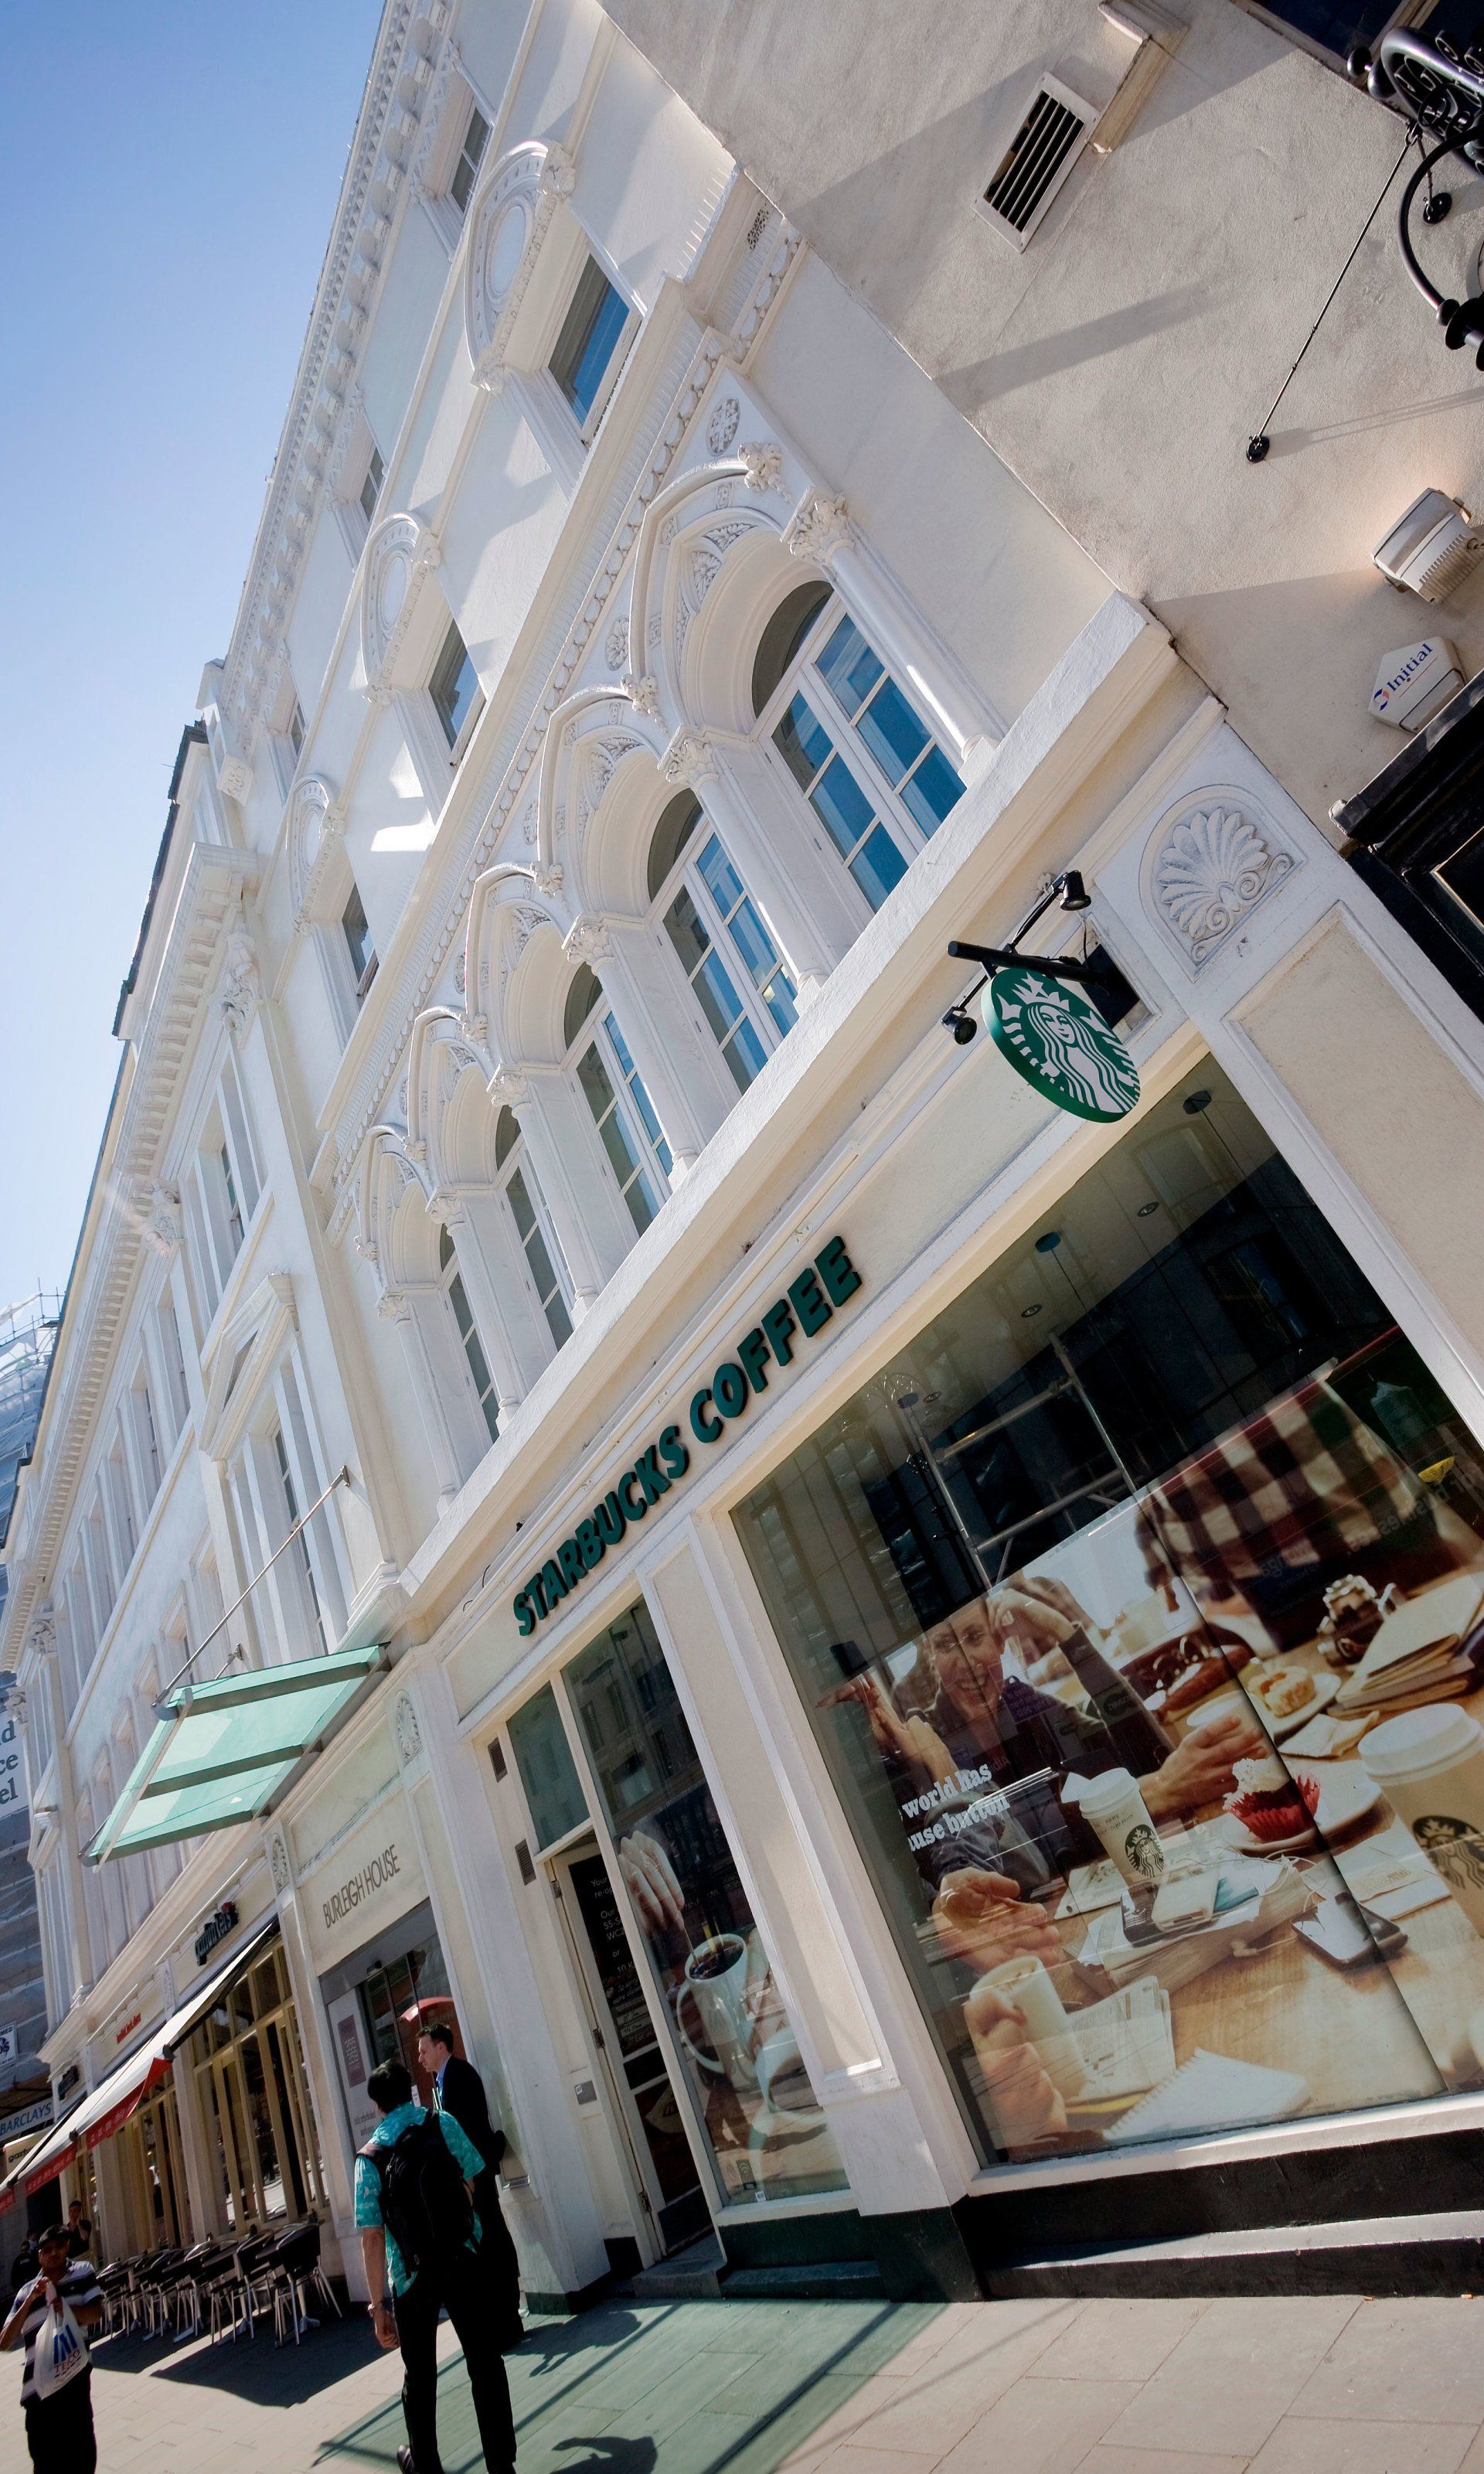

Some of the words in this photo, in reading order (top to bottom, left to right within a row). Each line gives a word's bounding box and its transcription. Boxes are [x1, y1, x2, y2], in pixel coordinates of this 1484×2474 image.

[1387, 643, 1433, 691] Initial
[513, 1425, 690, 1636] STARBUCKS
[689, 1235, 863, 1443] COFFEE
[0, 1719, 16, 1745] d
[902, 1775, 958, 1818] world
[955, 1763, 992, 1792] has
[942, 1794, 1011, 1835] button
[323, 1876, 366, 1929] BURLEIGH
[363, 1844, 400, 1896] HOUSE
[591, 1876, 608, 1887] Your
[601, 1909, 615, 1920] Our
[612, 1949, 621, 1958] or
[0, 2102, 52, 2136] BARCLAYS
